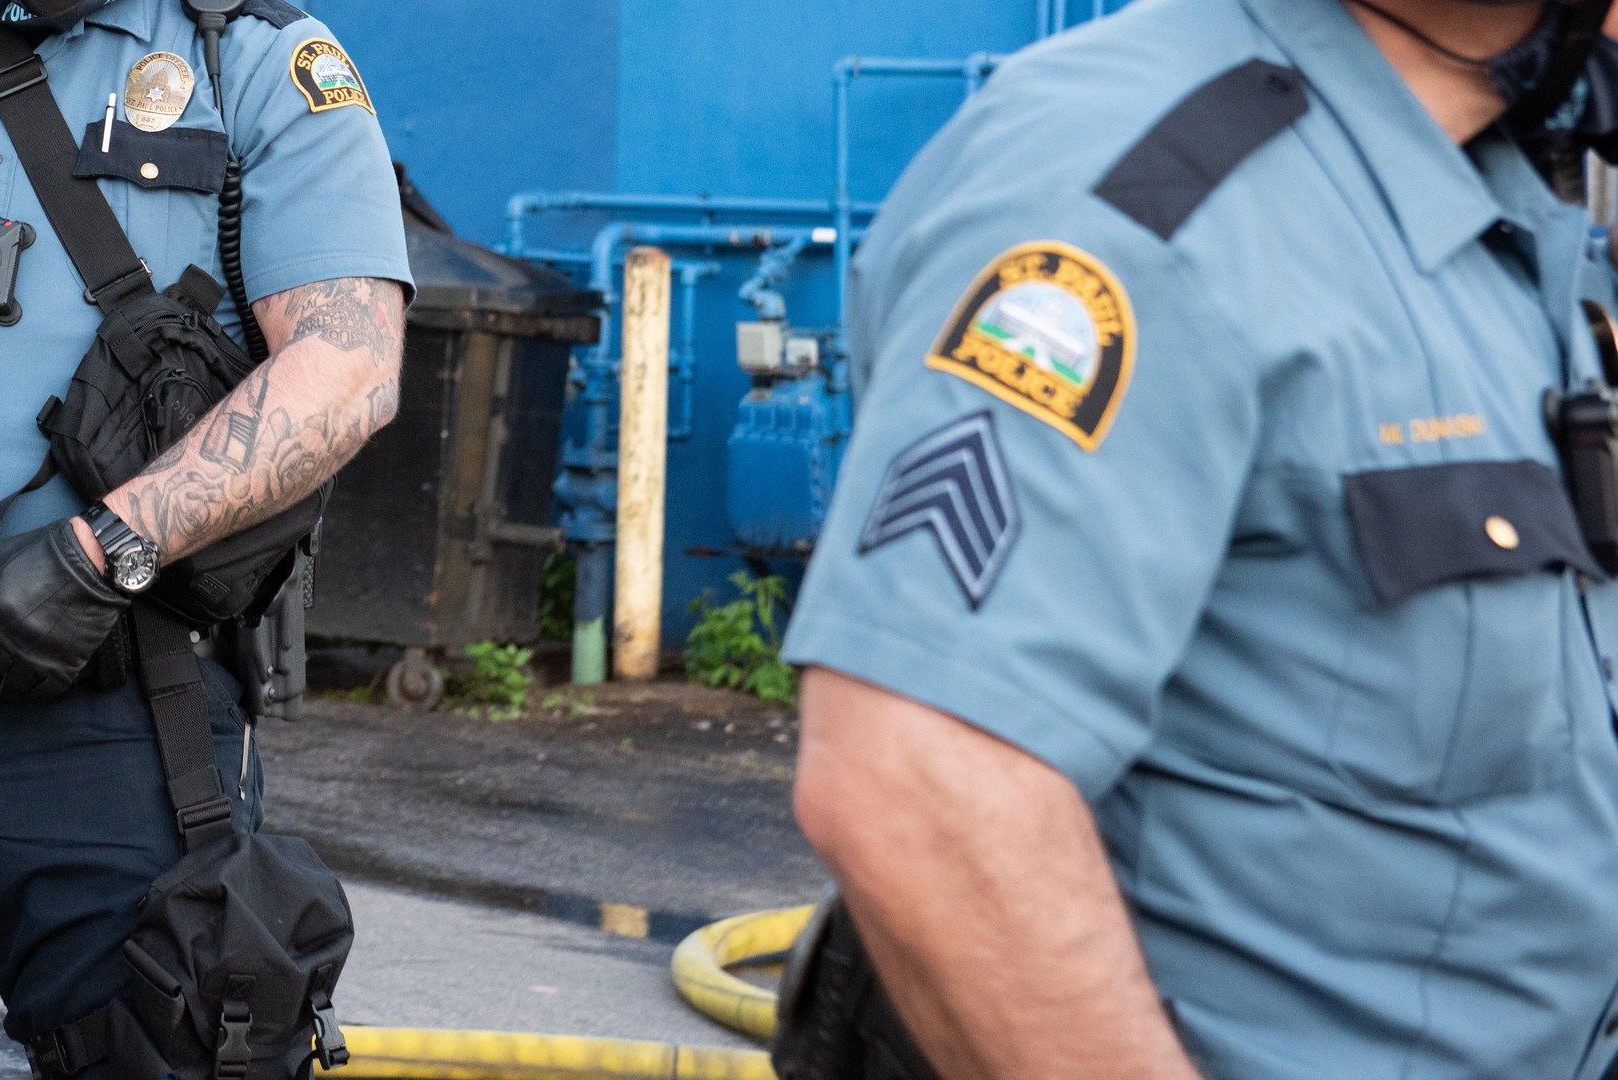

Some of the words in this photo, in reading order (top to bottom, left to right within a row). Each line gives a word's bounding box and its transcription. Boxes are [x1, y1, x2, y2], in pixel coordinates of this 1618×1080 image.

[136, 53, 164, 72] POLICE
[165, 53, 190, 80] OFFICER
[297, 48, 317, 70] ST.
[311, 43, 351, 68] PAUL
[155, 104, 180, 113] POLICE
[322, 87, 367, 105] POLICE
[951, 333, 1083, 419] POLICE
